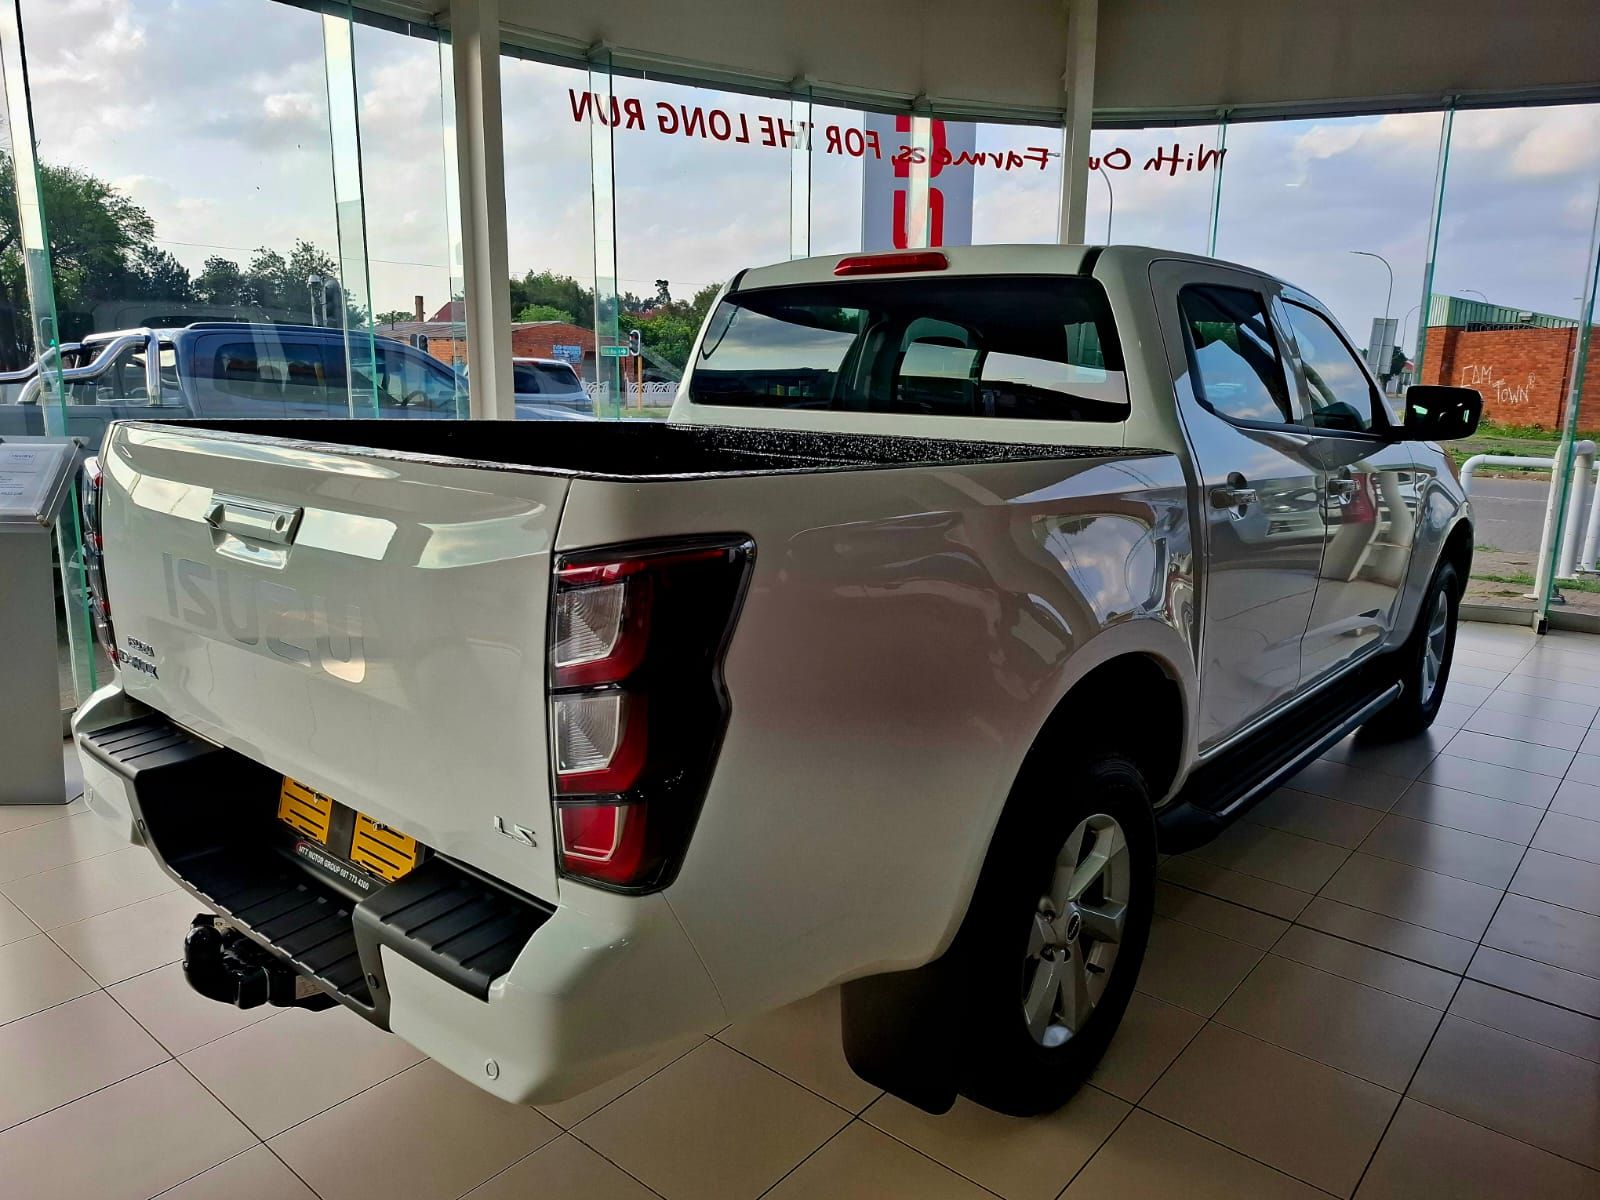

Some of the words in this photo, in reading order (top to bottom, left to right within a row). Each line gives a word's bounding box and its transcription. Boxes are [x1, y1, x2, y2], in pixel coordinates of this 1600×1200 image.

[494, 815, 537, 848] LS
[308, 850, 324, 865] MOTOR
[323, 860, 340, 873] GROUP
